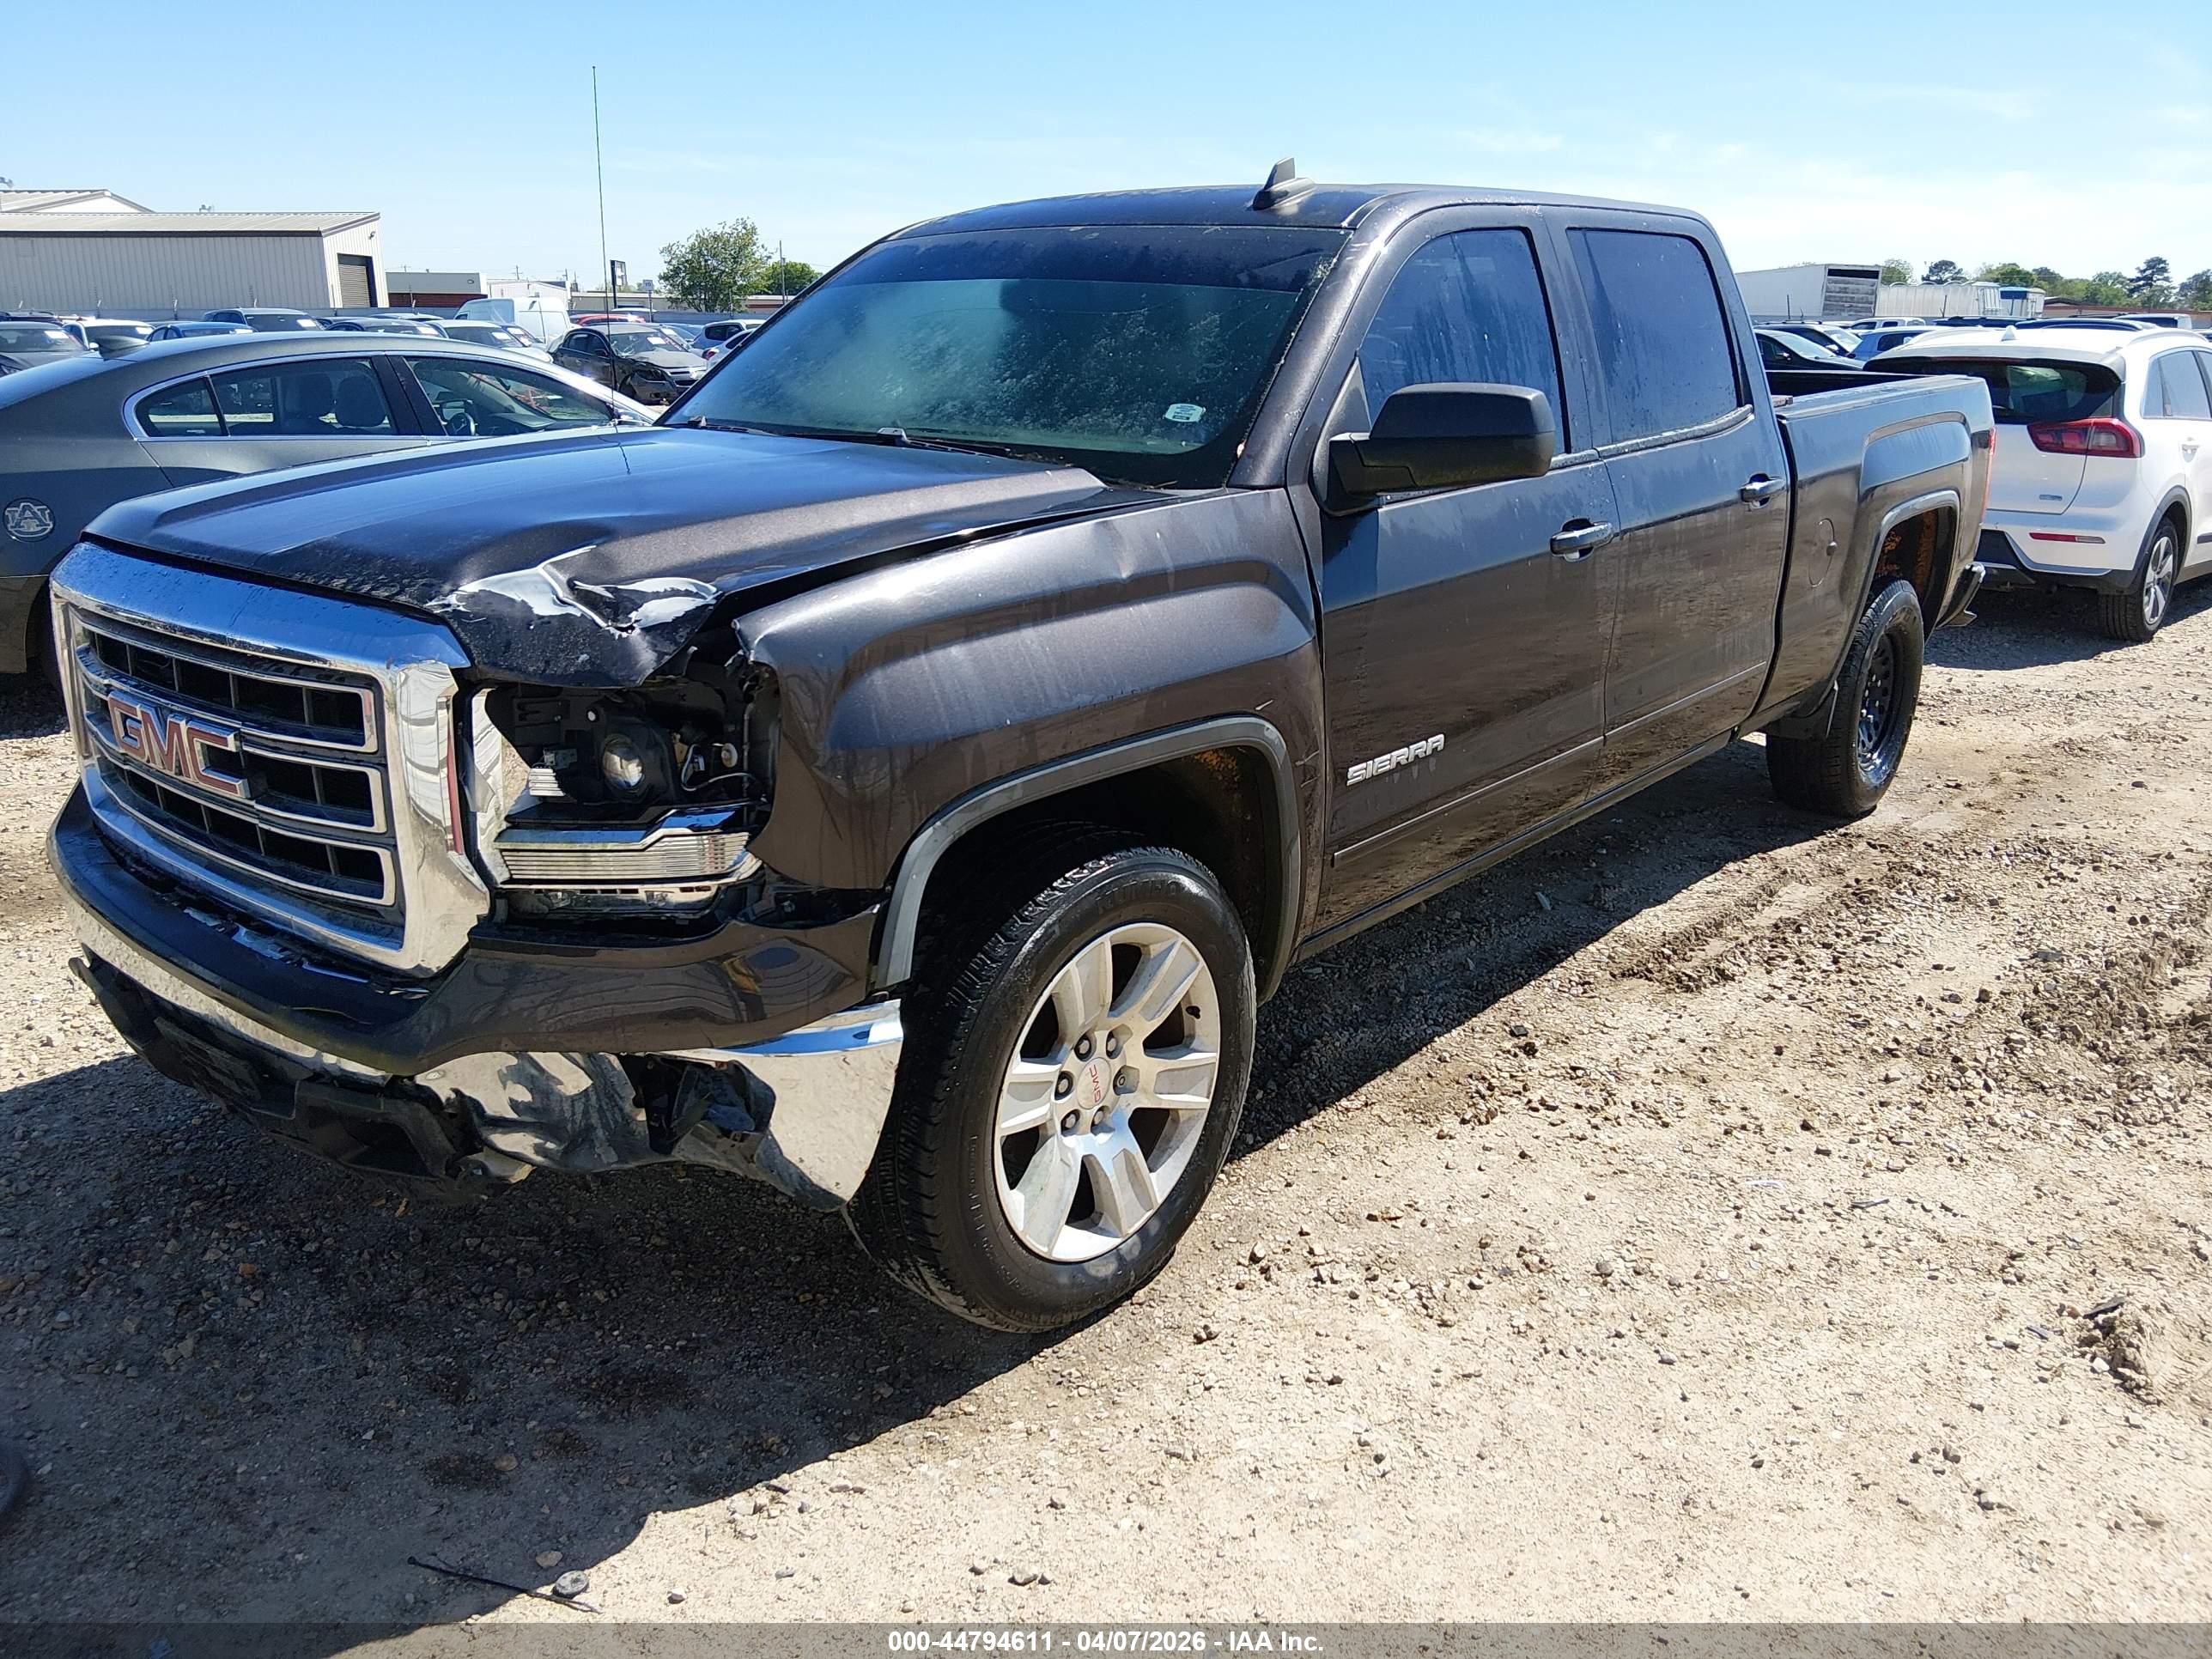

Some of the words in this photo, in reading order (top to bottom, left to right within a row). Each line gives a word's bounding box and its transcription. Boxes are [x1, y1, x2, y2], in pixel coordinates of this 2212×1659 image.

[108, 690, 251, 798] GMC
[1346, 733, 1444, 786] SIERRA
[1089, 1064, 1102, 1103] GMC
